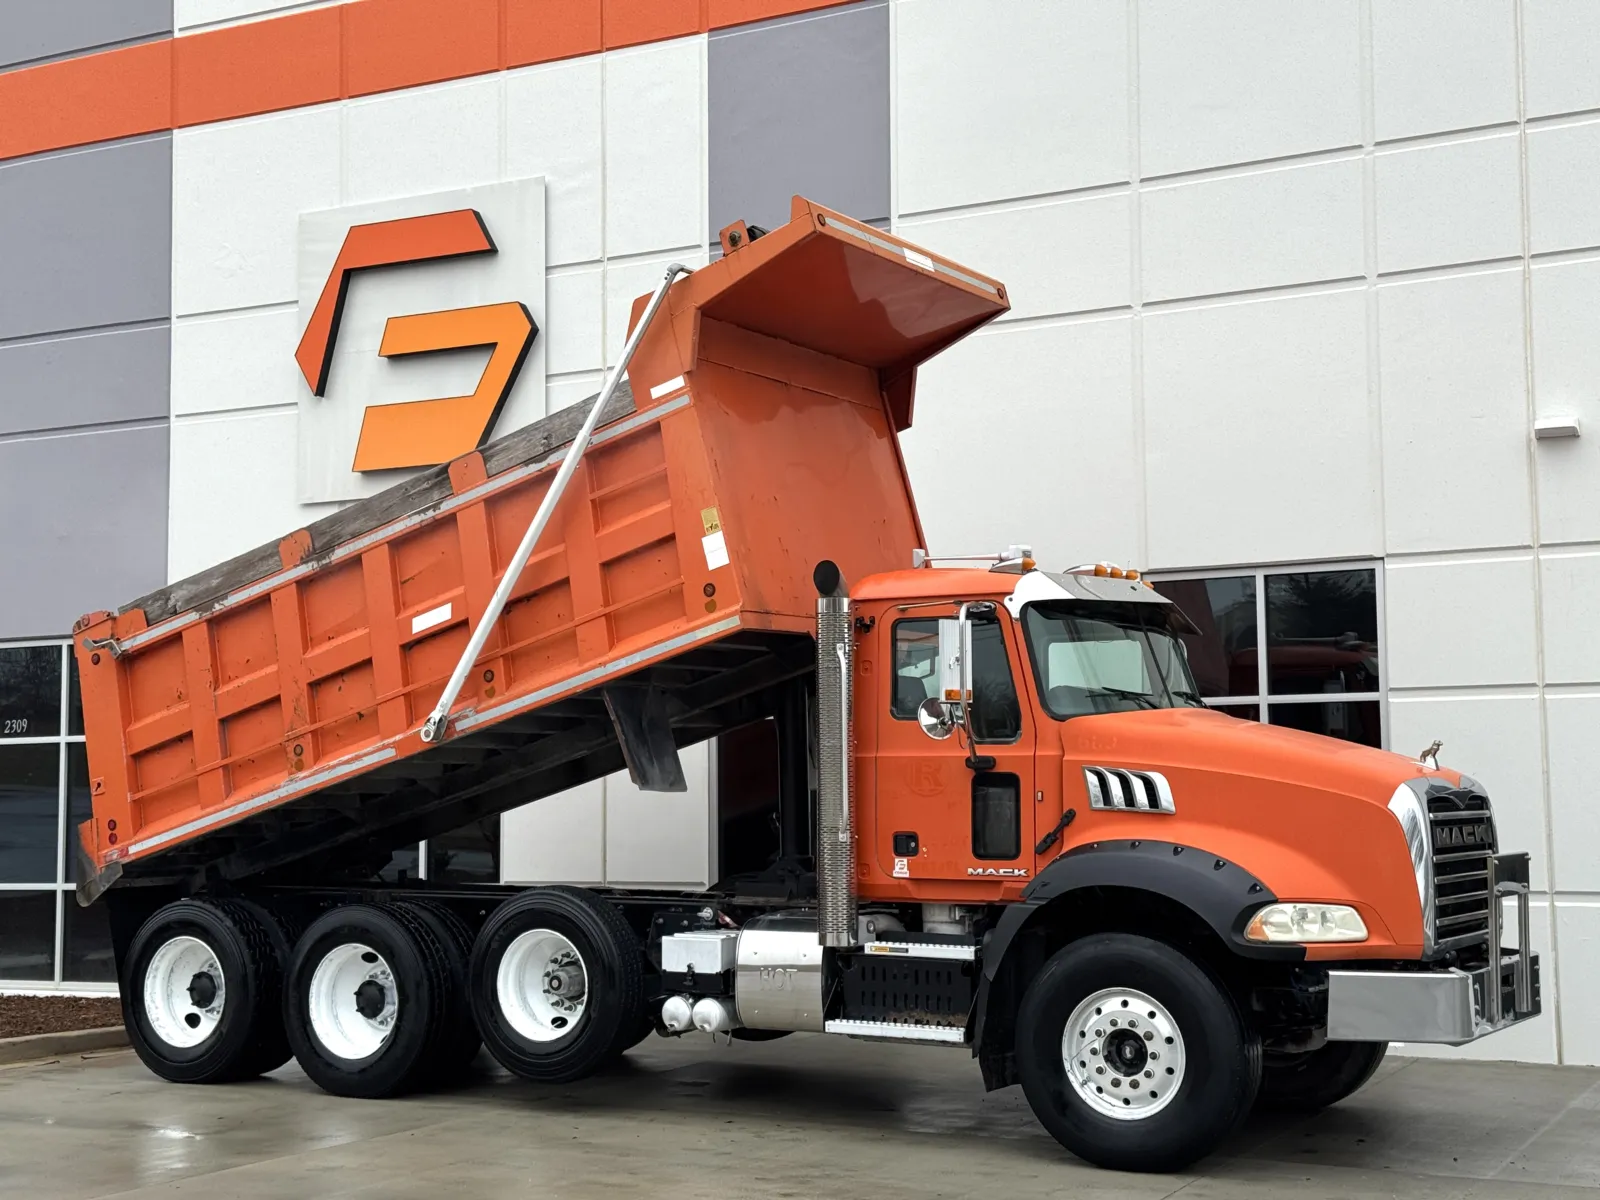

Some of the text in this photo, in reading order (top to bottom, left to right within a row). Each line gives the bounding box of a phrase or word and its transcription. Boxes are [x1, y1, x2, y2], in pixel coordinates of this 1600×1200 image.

[4, 718, 28, 734] 2309
[1436, 825, 1492, 845] MACK
[967, 867, 1029, 877] MACK
[760, 968, 798, 990] HOT
